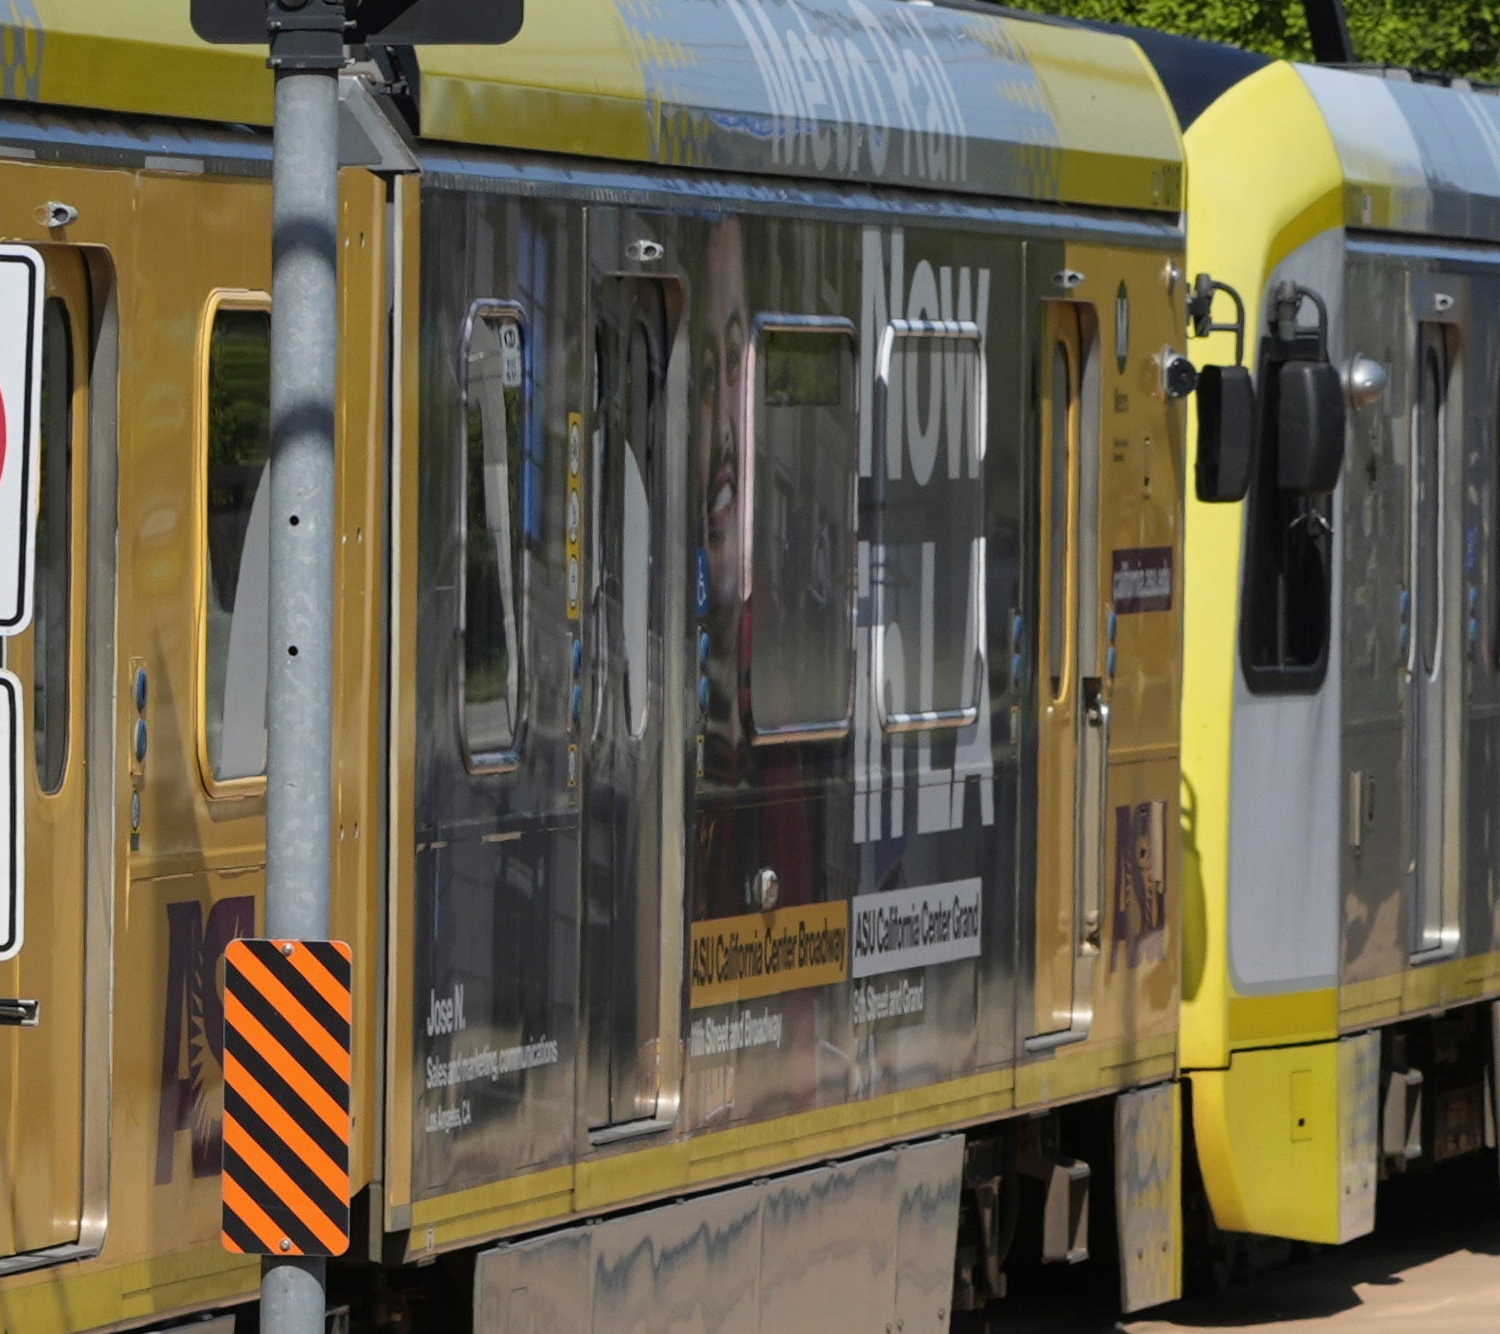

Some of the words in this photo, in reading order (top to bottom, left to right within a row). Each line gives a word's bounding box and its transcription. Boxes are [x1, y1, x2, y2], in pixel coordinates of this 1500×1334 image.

[858, 225, 990, 487] Now
[917, 536, 994, 835] LA
[692, 935, 714, 987] ASU
[716, 929, 762, 984] California
[764, 925, 797, 975] Center
[799, 917, 846, 972] Broadway
[856, 909, 876, 957] ASU
[877, 902, 920, 954] California
[921, 900, 951, 946] Center
[952, 891, 980, 941] Grand
[426, 988, 453, 1037] Jose
[454, 984, 467, 1032] N.
